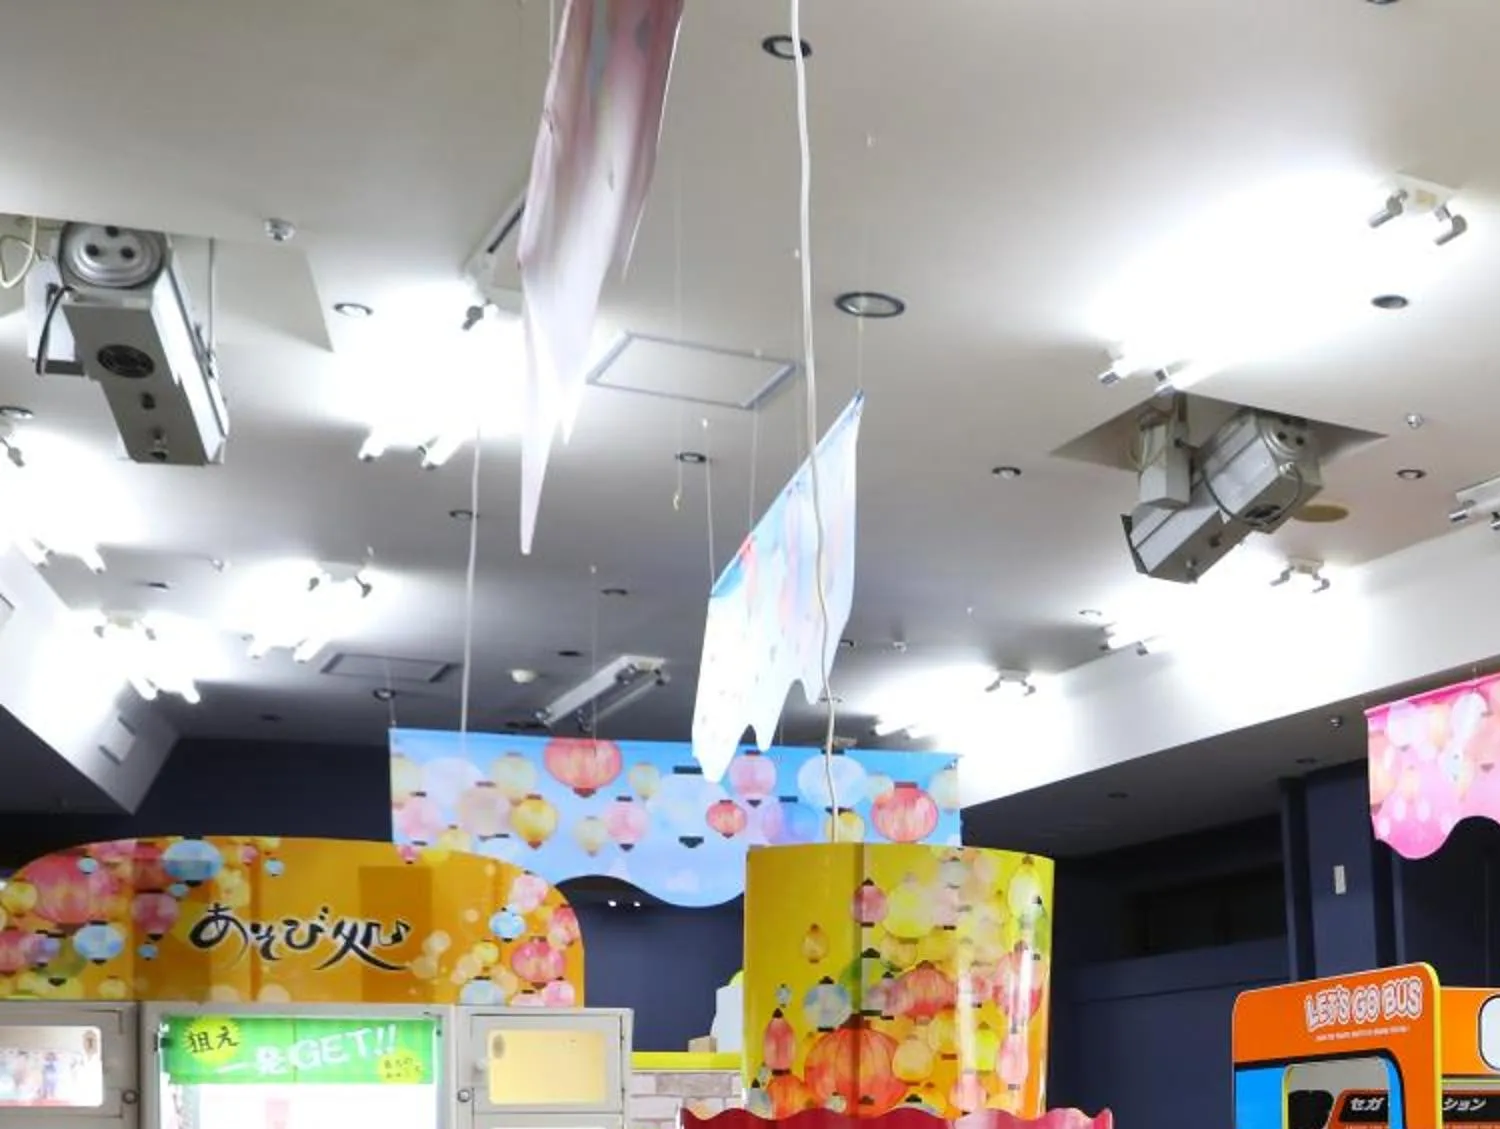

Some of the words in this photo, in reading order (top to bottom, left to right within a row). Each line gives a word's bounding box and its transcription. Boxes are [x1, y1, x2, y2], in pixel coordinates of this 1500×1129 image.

[189, 903, 410, 970] あそび処
[1305, 985, 1350, 1032] LET'S
[1353, 984, 1380, 1024] GO
[1382, 976, 1423, 1020] BUS
[190, 1025, 240, 1052] 狙え
